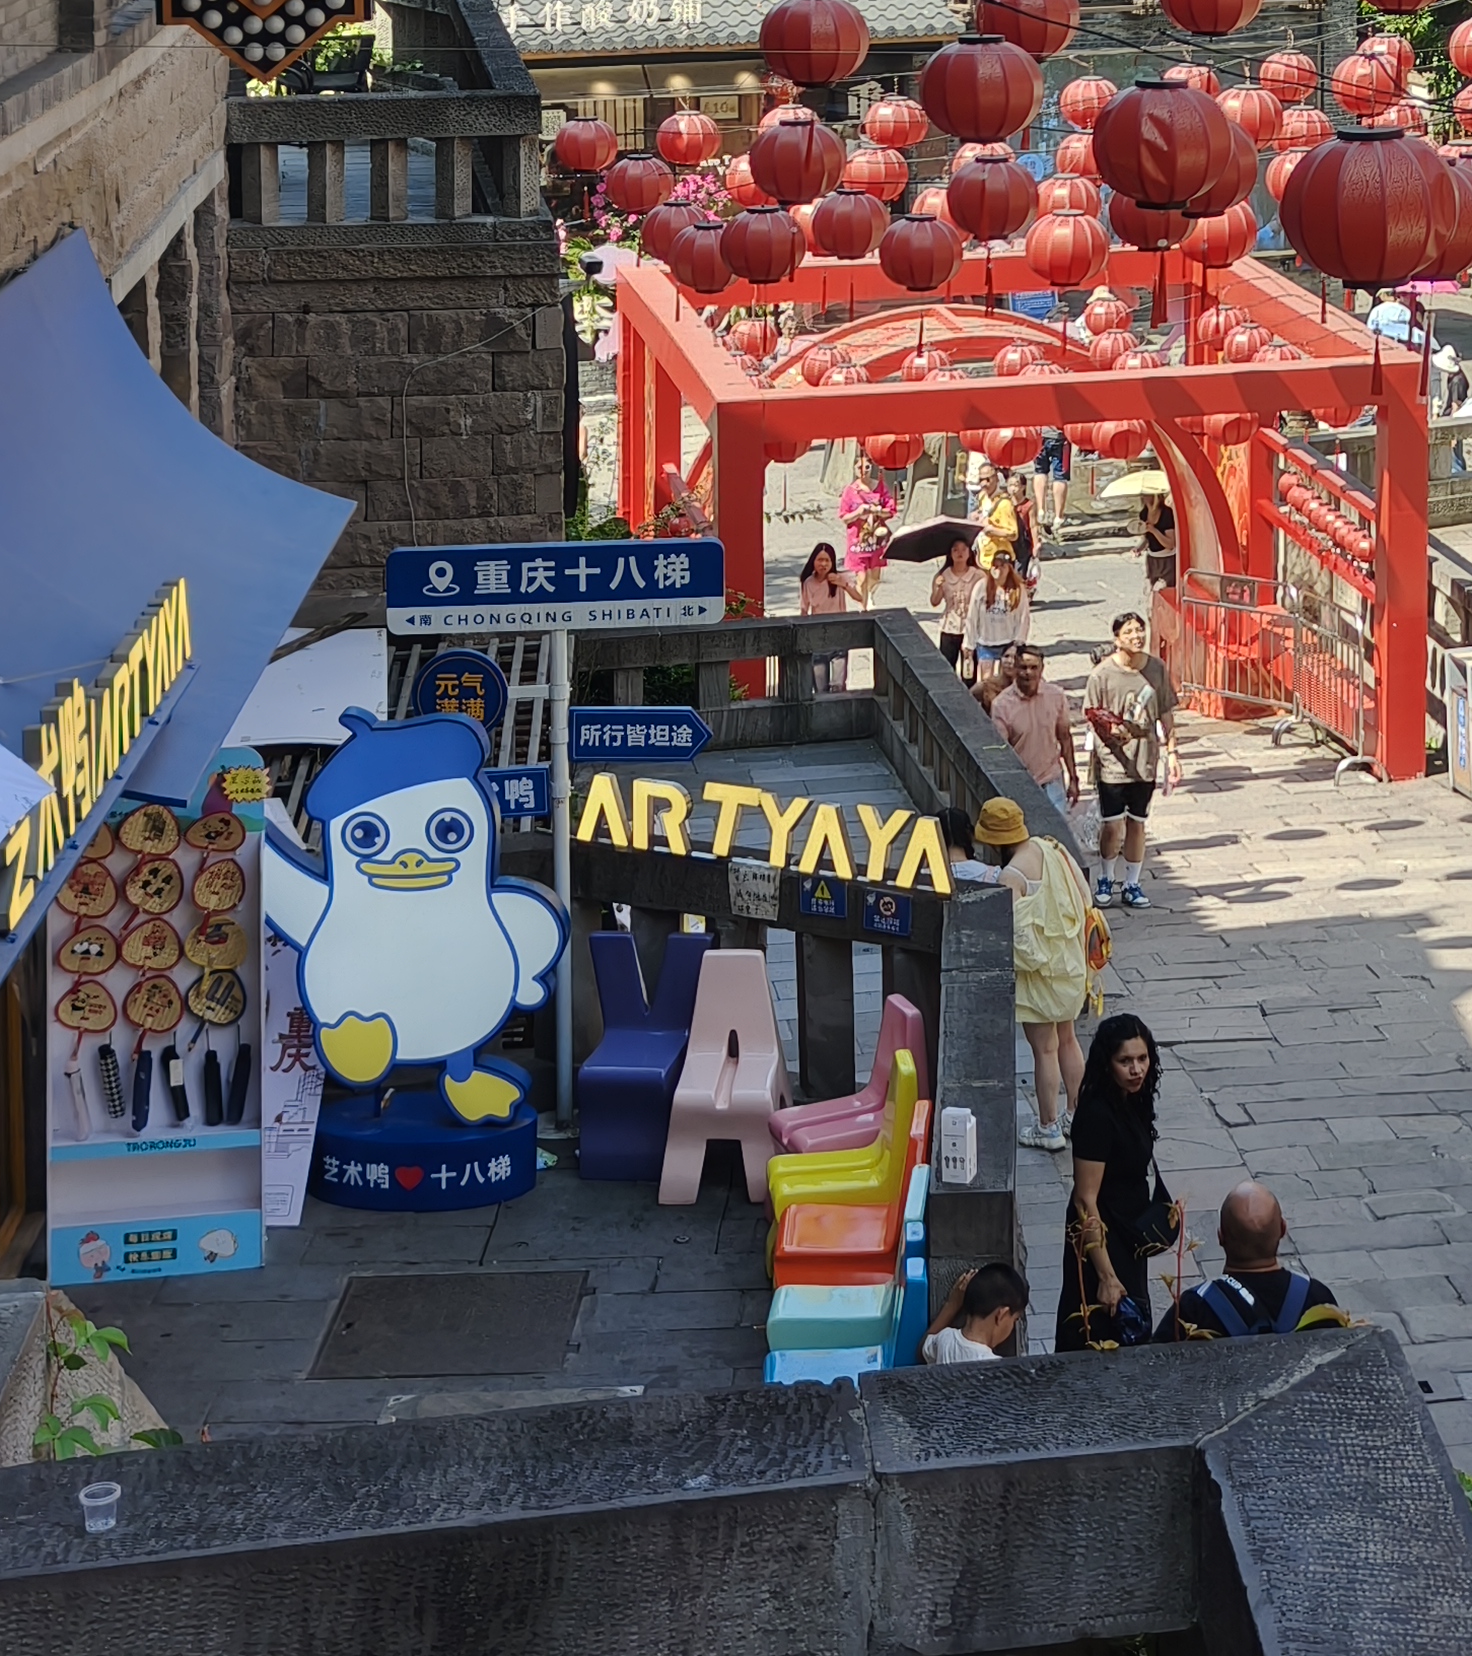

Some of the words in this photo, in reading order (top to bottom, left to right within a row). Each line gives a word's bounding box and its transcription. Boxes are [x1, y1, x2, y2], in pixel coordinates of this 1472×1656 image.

[473, 552, 692, 595] 重庆十八梯
[419, 613, 433, 627] 南
[443, 609, 573, 626] CHONGQING
[588, 606, 672, 622] SHIBATI
[681, 605, 695, 618] 北
[435, 673, 485, 697] 元气
[580, 723, 693, 748] 所行皆坦途
[575, 771, 955, 895] ARTYAYA
[323, 1155, 389, 1190] 艺术鸭
[430, 1153, 512, 1190] 十八梯
